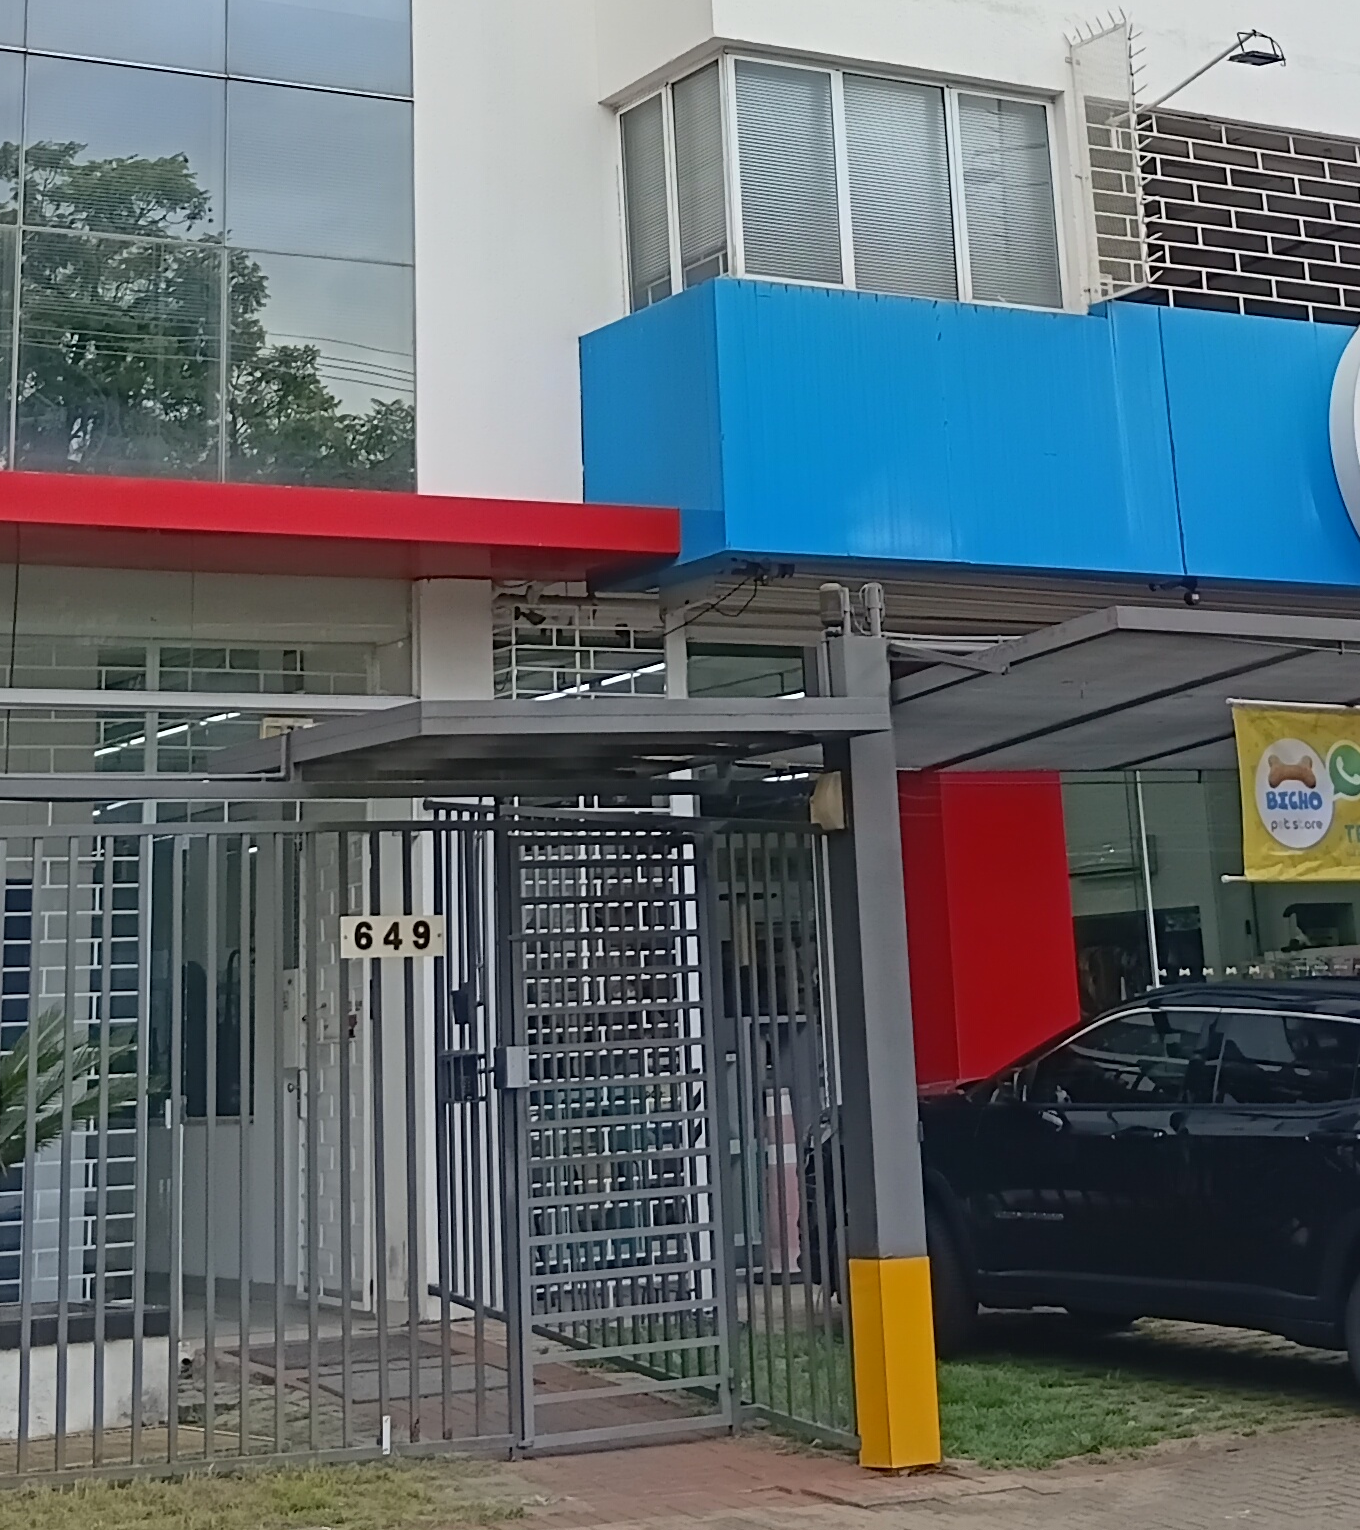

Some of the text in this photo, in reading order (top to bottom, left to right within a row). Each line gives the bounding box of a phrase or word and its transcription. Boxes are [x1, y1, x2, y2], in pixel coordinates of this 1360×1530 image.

[1266, 790, 1323, 810] BICHO
[1271, 817, 1323, 832] pt sore
[353, 920, 432, 951] 649
